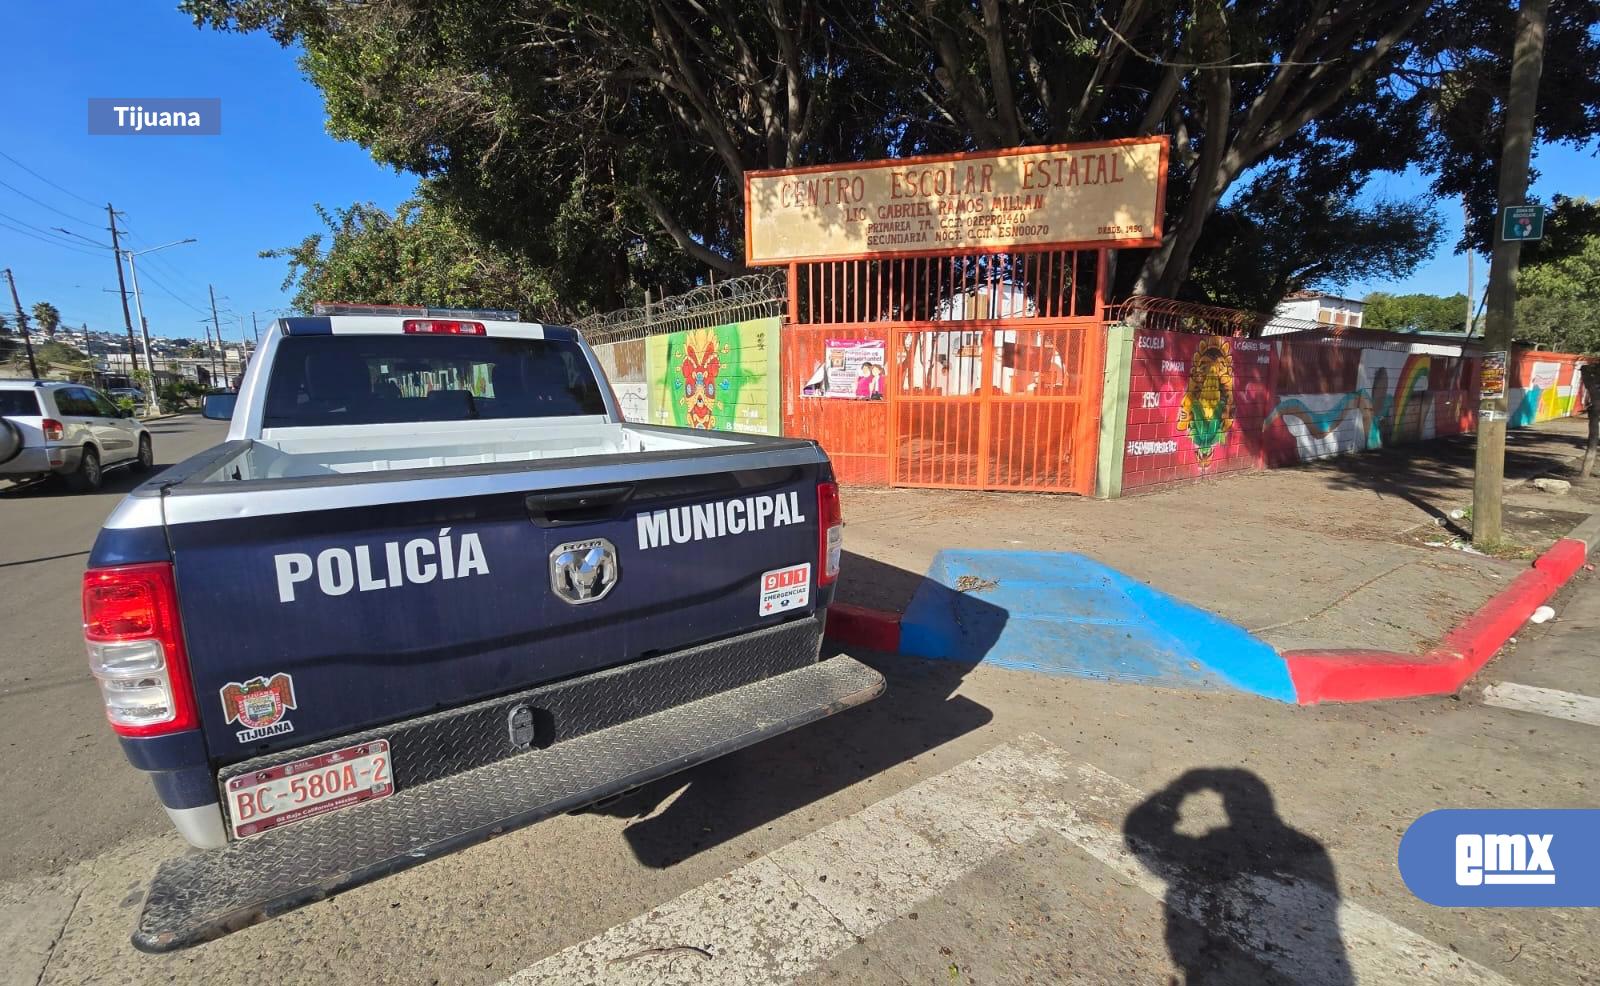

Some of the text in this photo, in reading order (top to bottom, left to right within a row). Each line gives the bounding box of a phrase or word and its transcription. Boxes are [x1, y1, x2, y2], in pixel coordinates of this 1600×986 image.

[781, 153, 1124, 209] CENTRO ESCOLAR ESTATAL
[877, 201, 932, 220] GABRIEL
[938, 198, 984, 217] RAMOS
[991, 194, 1044, 212] MILLAN
[867, 221, 911, 235] PRIMARIA
[867, 232, 928, 246] SECUNDARIA
[1138, 336, 1165, 349] ESCUELA
[1142, 391, 1160, 408] 1950
[636, 491, 806, 551] MUNICIPAL
[274, 527, 490, 603] POLICÍA
[767, 570, 804, 588] 911
[764, 587, 806, 602] EMERGENCIAS
[239, 722, 292, 742] TIJUANA
[237, 757, 388, 821] BC-580A-2
